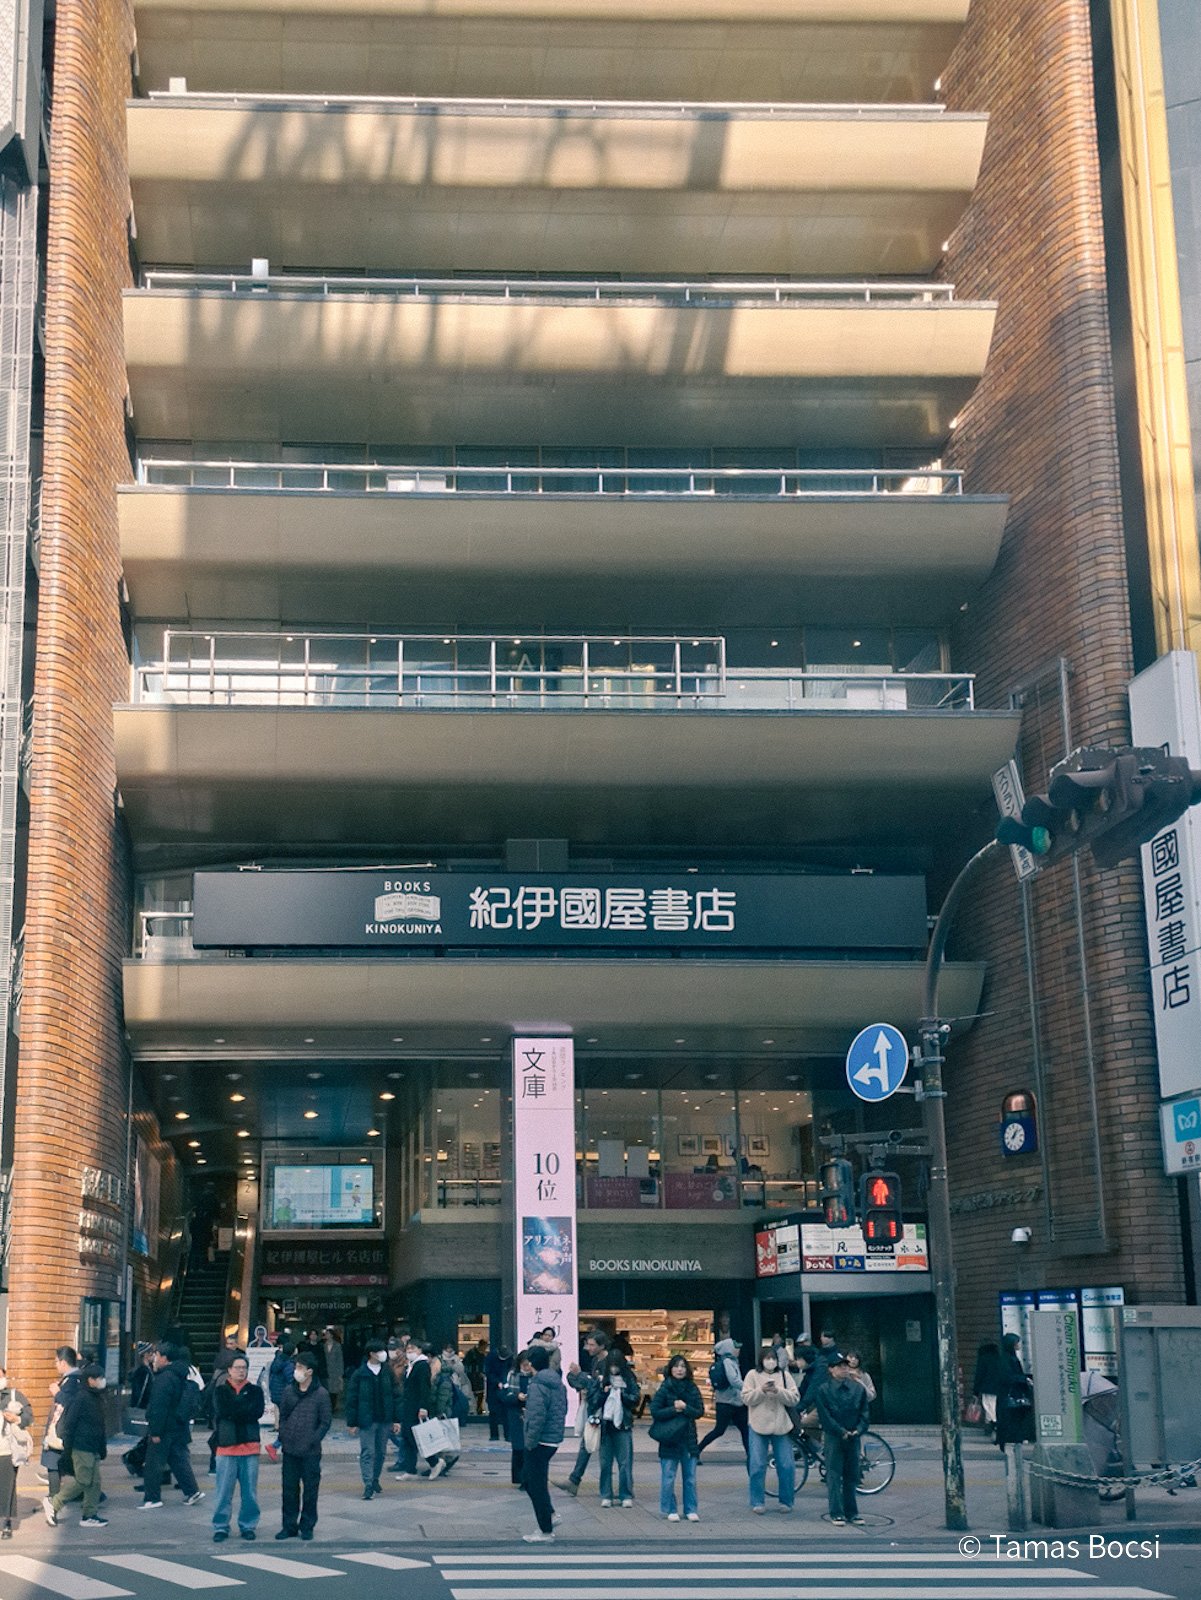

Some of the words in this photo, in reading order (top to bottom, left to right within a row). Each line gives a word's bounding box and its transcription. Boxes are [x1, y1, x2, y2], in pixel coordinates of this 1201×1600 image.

[384, 881, 431, 892] BOOKS
[469, 886, 736, 931] 紀伊國屋書店
[1152, 829, 1190, 1010] 國屋書店
[365, 924, 442, 934] KINOKUNIYA
[522, 1048, 546, 1098] 文庫
[589, 1260, 630, 1271] BOOKS
[632, 1260, 702, 1271] KINOKUNIYA
[1063, 1314, 1074, 1344] Clean
[1065, 1347, 1077, 1394] Shinjuku
